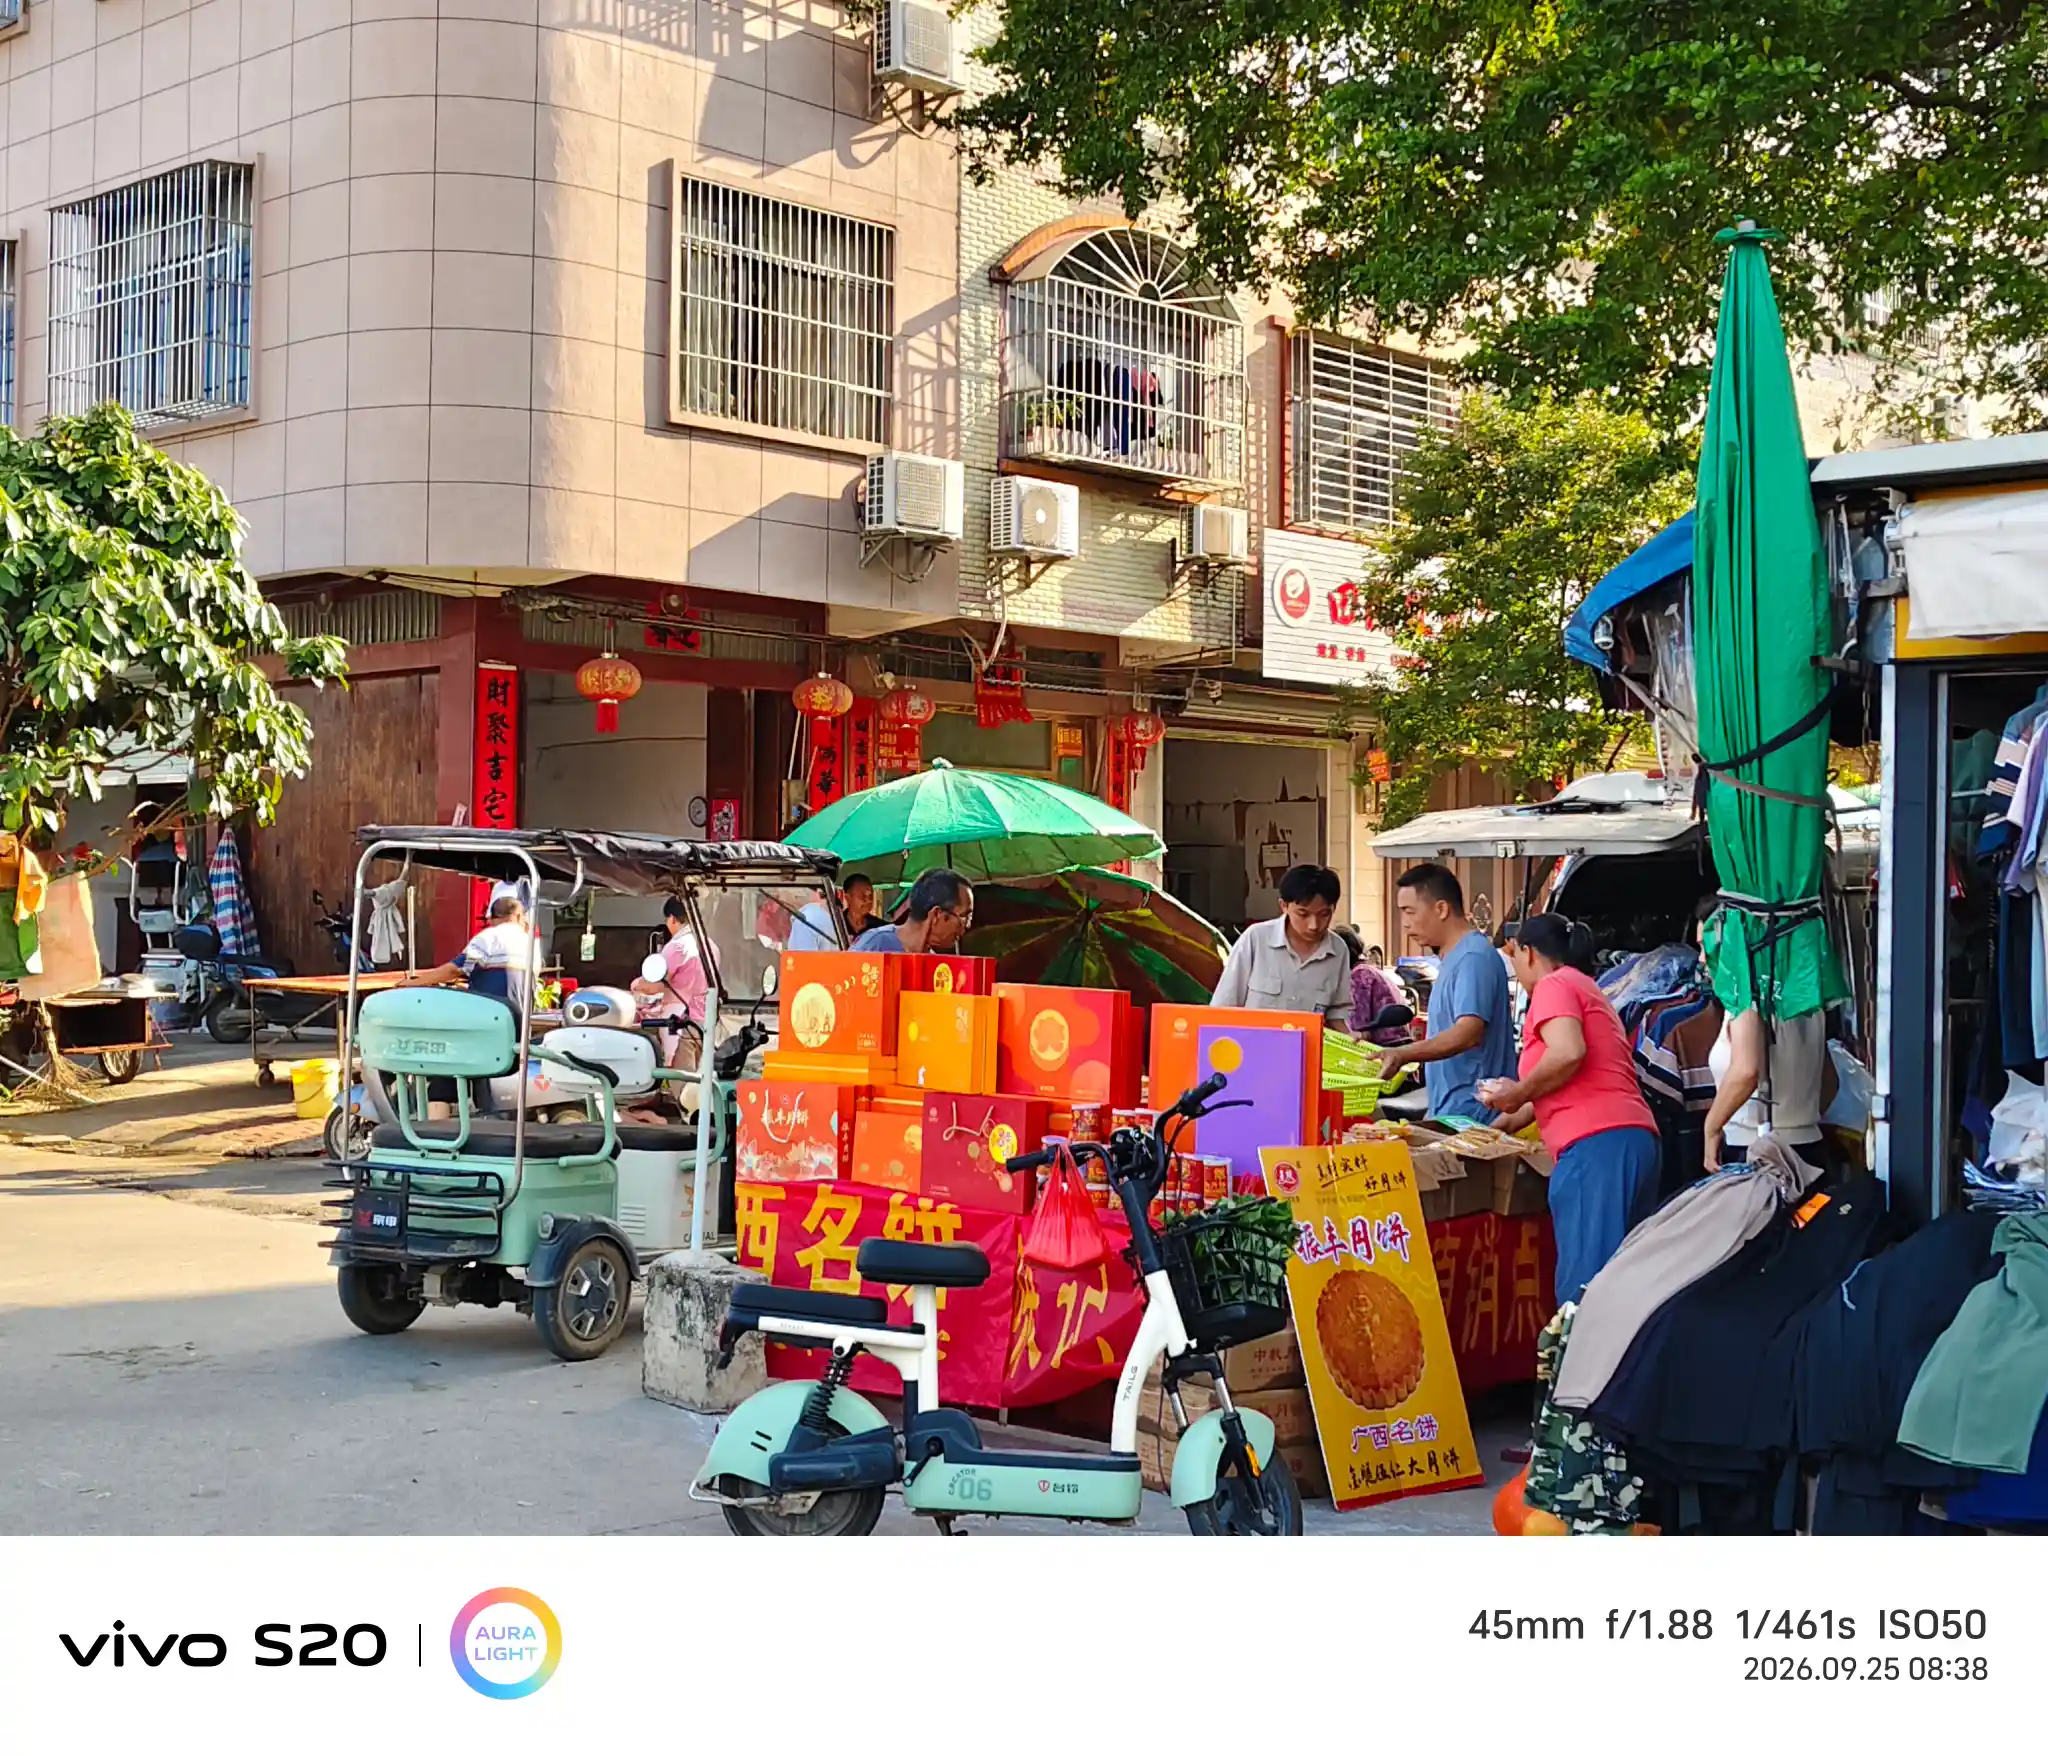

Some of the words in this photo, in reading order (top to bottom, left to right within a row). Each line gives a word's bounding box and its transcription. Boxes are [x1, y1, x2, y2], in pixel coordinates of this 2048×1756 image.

[484, 676, 511, 827] 財聚吉宅
[1364, 1169, 1408, 1192] 好月饼
[1296, 1212, 1411, 1265] 振丰月饼
[1123, 1366, 1138, 1401] TAILG
[1351, 1414, 1438, 1452] 广西名饼
[948, 1468, 977, 1495] CREATOR
[959, 1477, 993, 1501] 06
